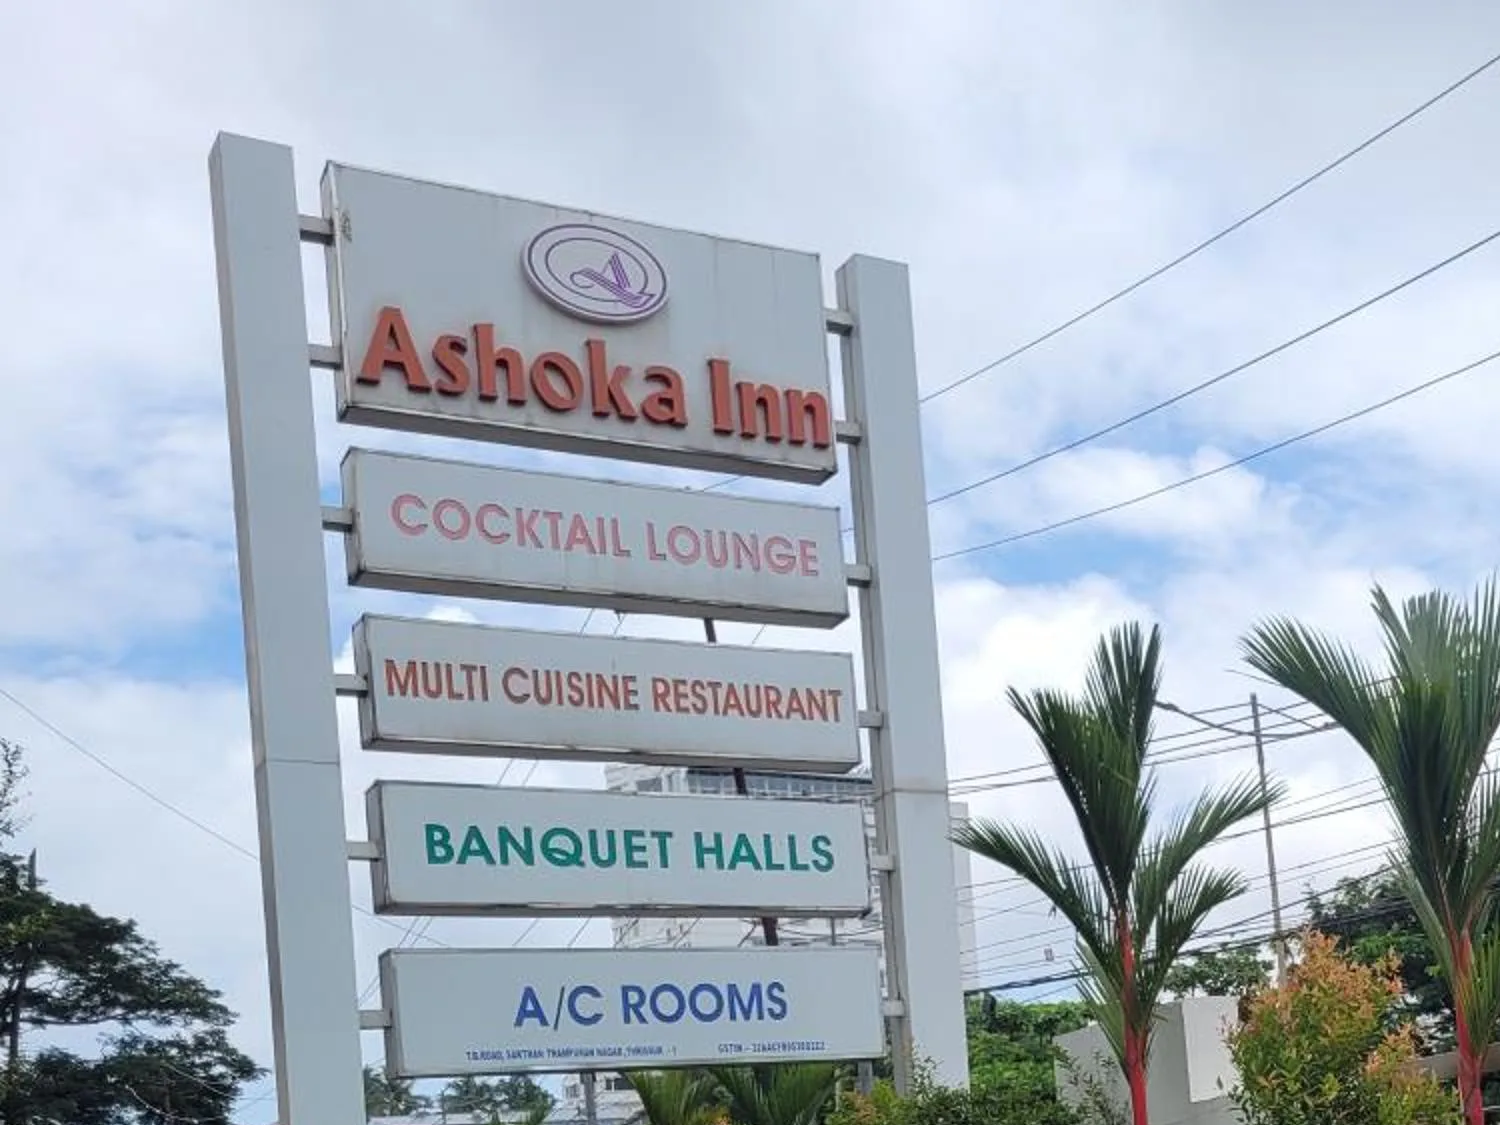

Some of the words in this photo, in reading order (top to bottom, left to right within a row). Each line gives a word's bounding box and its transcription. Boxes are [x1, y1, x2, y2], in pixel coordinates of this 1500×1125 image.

[356, 306, 688, 427] Ashoka
[706, 358, 832, 449] Inn
[389, 494, 632, 559] COCKTAIL
[646, 522, 820, 577] LOUNGE
[384, 659, 490, 702] MULTI
[501, 667, 640, 712] CUISINE
[651, 677, 843, 724] RESTAURANT
[424, 823, 673, 869] BANQUET
[693, 831, 836, 873] HALLS
[513, 984, 604, 1032] A/C
[621, 981, 788, 1025] ROOMS
